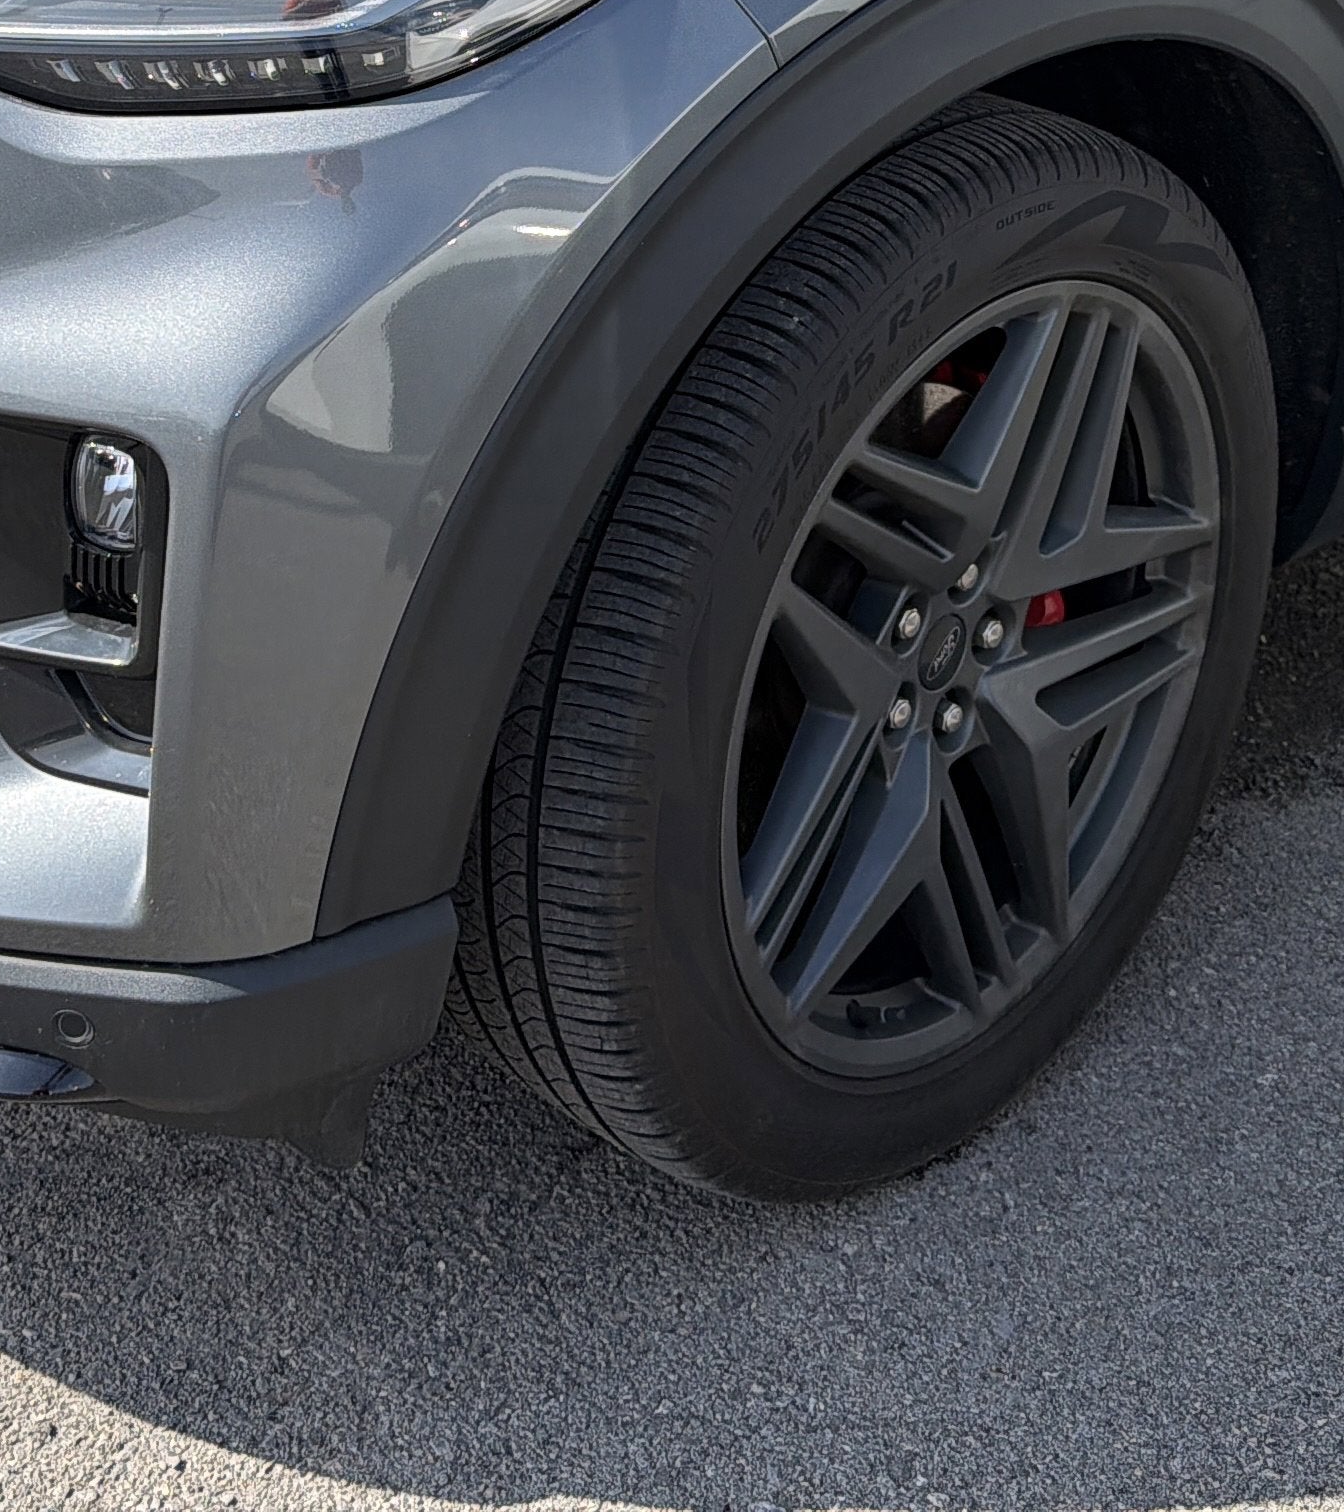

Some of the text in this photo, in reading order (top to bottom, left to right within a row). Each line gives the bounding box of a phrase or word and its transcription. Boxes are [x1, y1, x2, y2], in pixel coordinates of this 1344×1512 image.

[995, 200, 1058, 232] OUTSIDE
[752, 340, 877, 556] 275/45
[887, 259, 958, 346] R21
